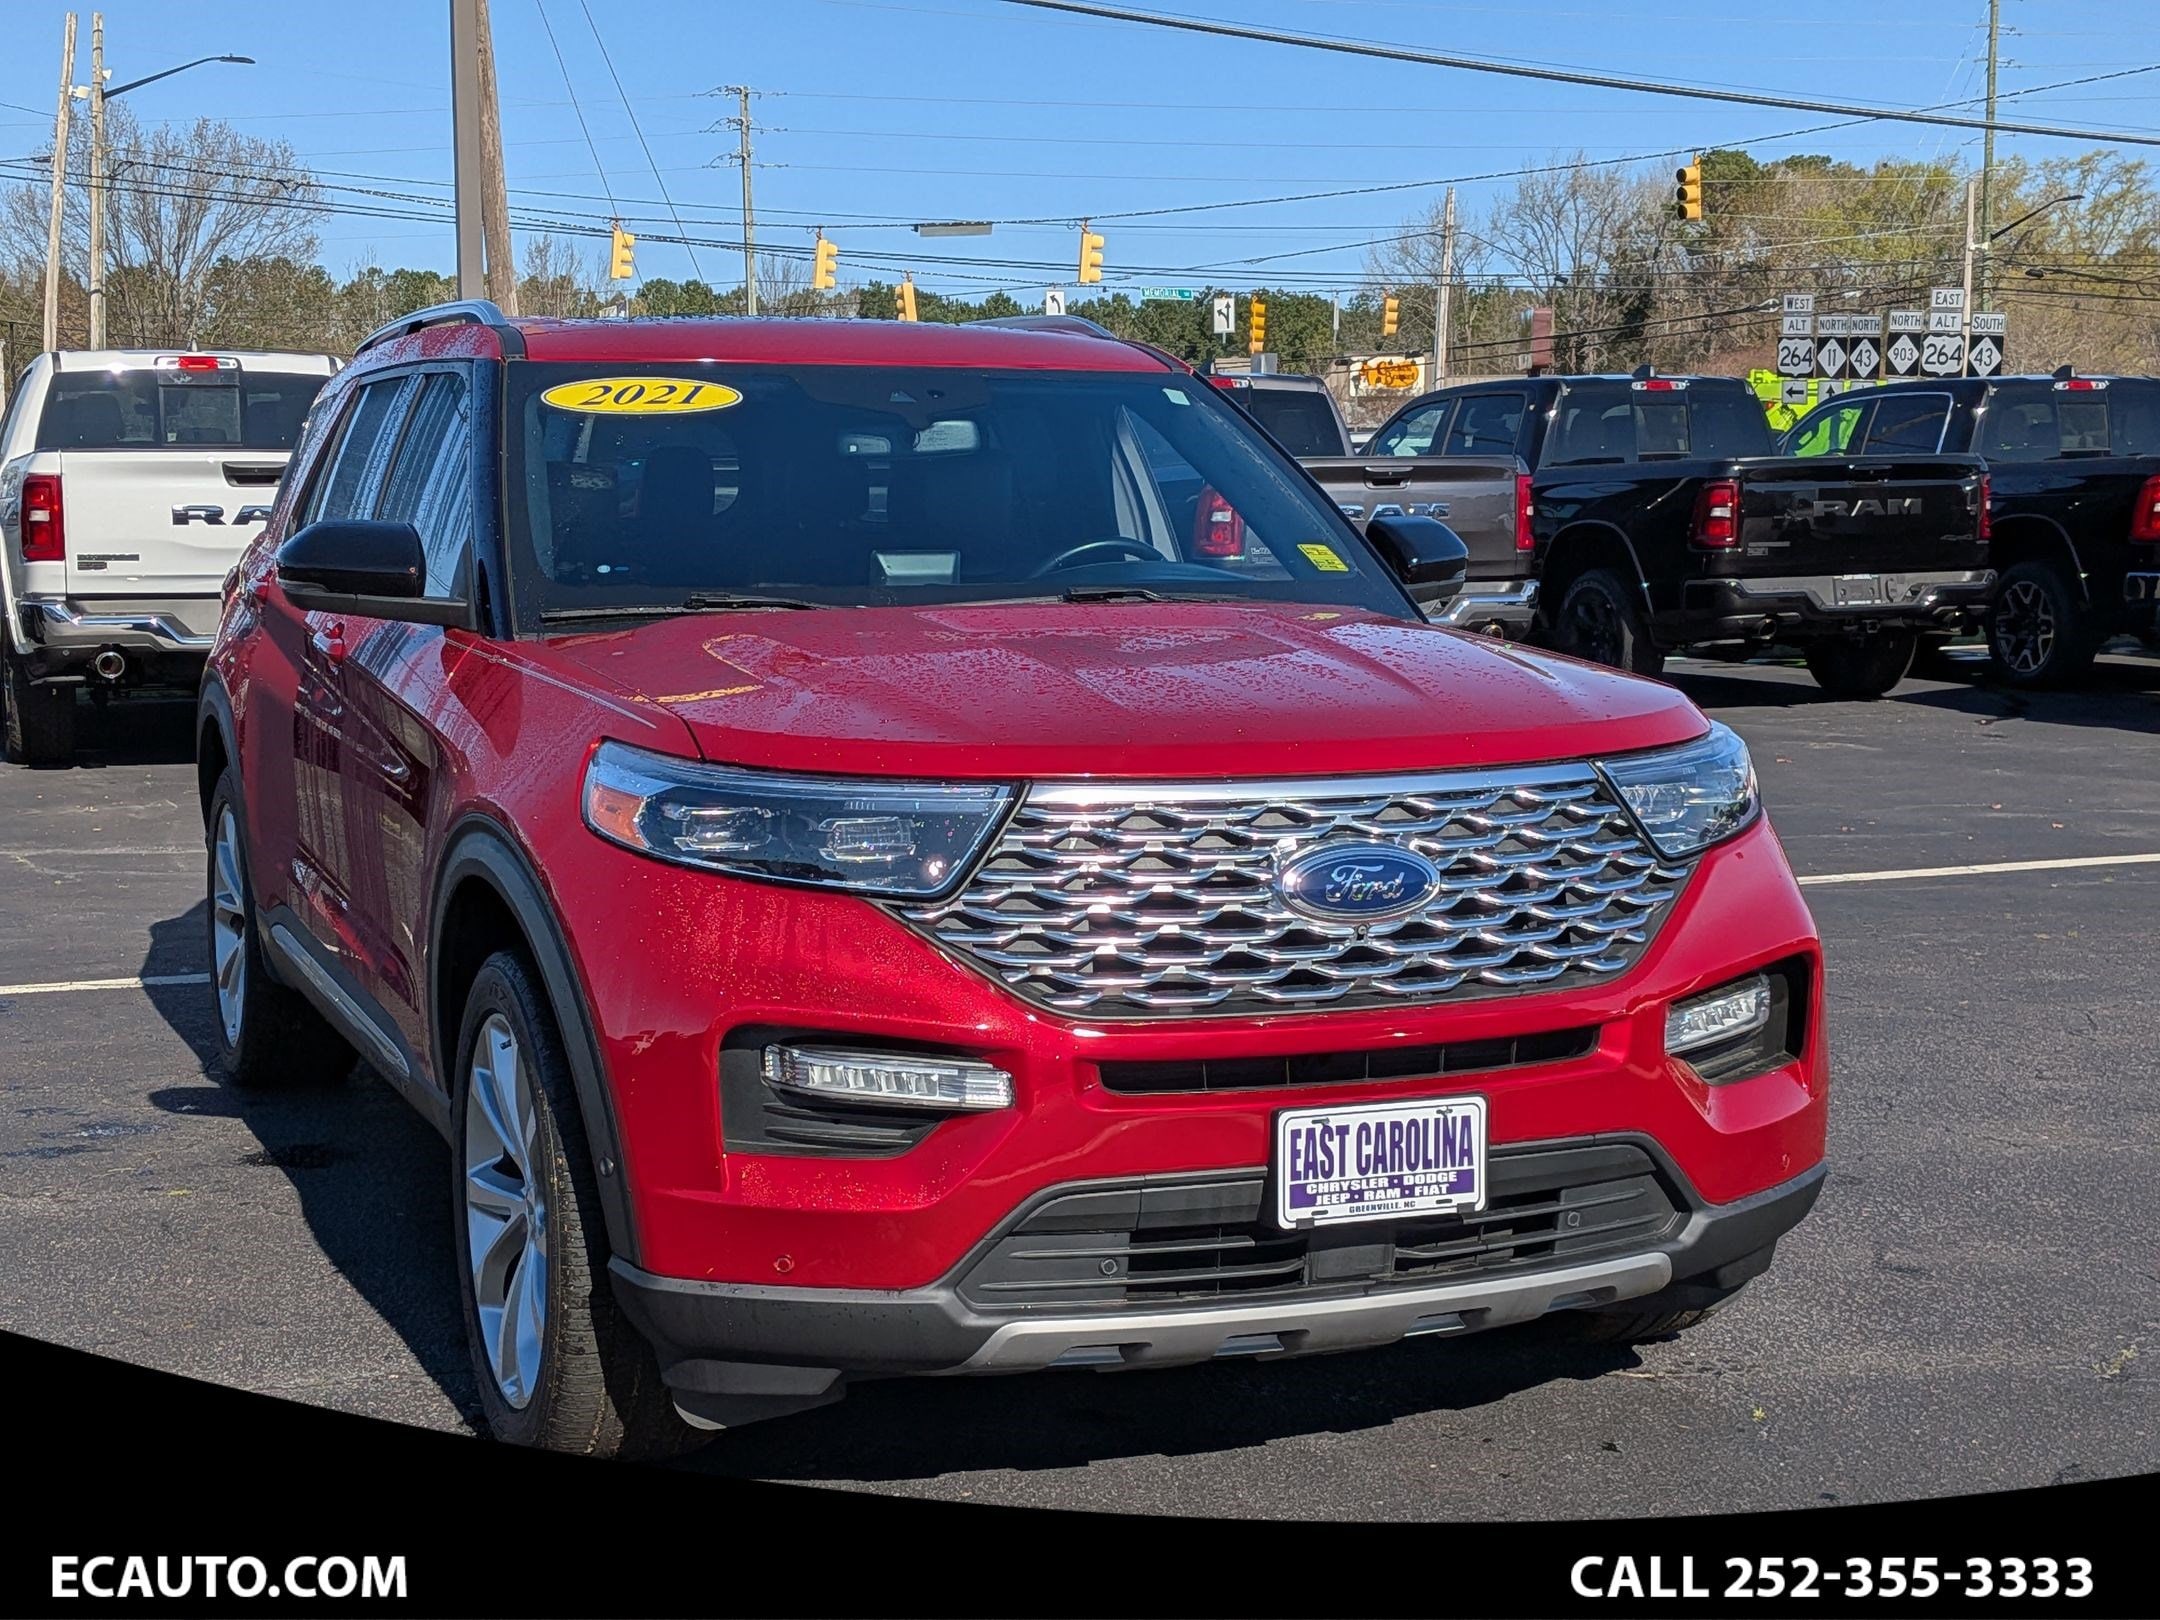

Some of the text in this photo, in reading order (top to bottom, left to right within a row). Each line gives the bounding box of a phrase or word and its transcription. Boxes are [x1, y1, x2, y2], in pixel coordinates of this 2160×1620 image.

[1787, 297, 1810, 309] WEST
[1935, 291, 1961, 305] EAST
[1788, 319, 1807, 331] ALT
[1820, 319, 1846, 331] NORTH
[1852, 319, 1880, 331] NORTH
[1891, 314, 1921, 326] NORTH
[1935, 315, 1957, 327] ALT
[1973, 316, 2003, 330] SOUTH
[1780, 345, 1812, 367] 264
[1827, 348, 1837, 367] 11
[1854, 348, 1872, 367] 43
[1893, 347, 1914, 361] 903
[1924, 343, 1962, 366] 264
[1974, 347, 1993, 367] 43
[578, 384, 705, 406] 2021
[171, 504, 273, 525] RA
[1813, 498, 1922, 517] RAM
[1325, 864, 1405, 902] Ford
[1290, 1115, 1474, 1182] EAST CAROLINA
[1306, 1171, 1458, 1195] CHRYSLER DODGE
[1315, 1183, 1449, 1207] JEEP RAM FIAT
